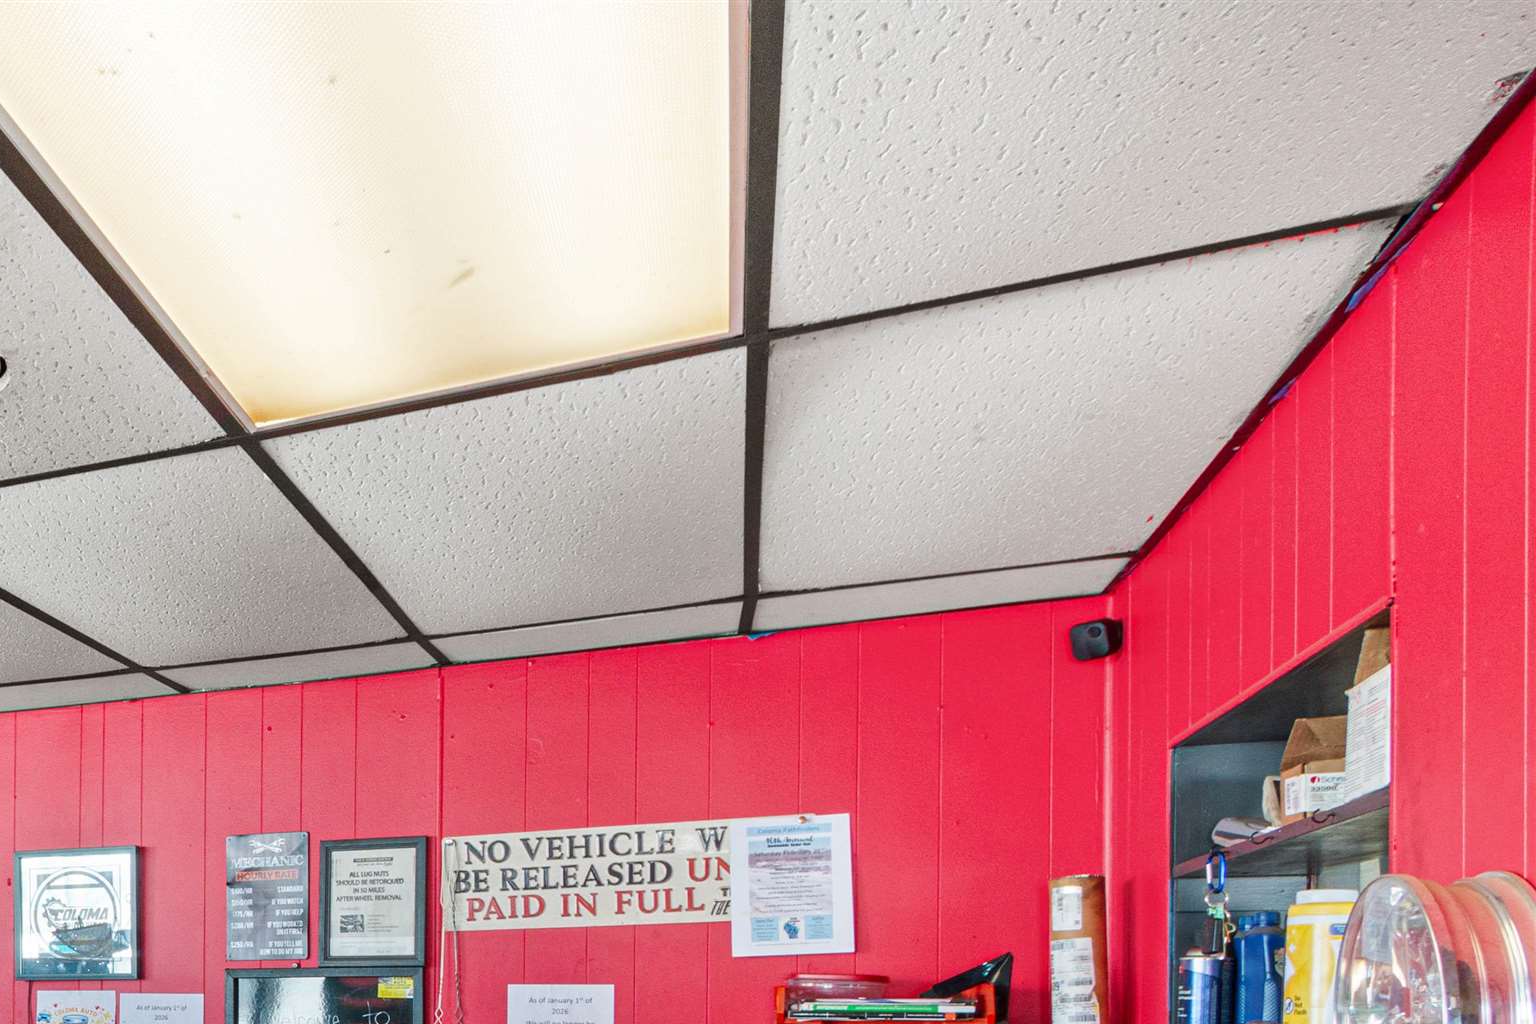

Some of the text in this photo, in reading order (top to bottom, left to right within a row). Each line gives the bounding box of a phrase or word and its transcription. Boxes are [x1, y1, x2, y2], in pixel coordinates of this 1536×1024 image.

[465, 840, 510, 864] NO
[520, 830, 675, 860] VEHICLE
[232, 855, 304, 868] MECHANIC
[237, 870, 298, 880] HOURLY RATE
[454, 870, 489, 894] BE
[500, 860, 672, 890] RELEASED
[466, 887, 705, 921] PAID IN FULL
[48, 908, 108, 921] COLOMA
[547, 997, 573, 1005] January
